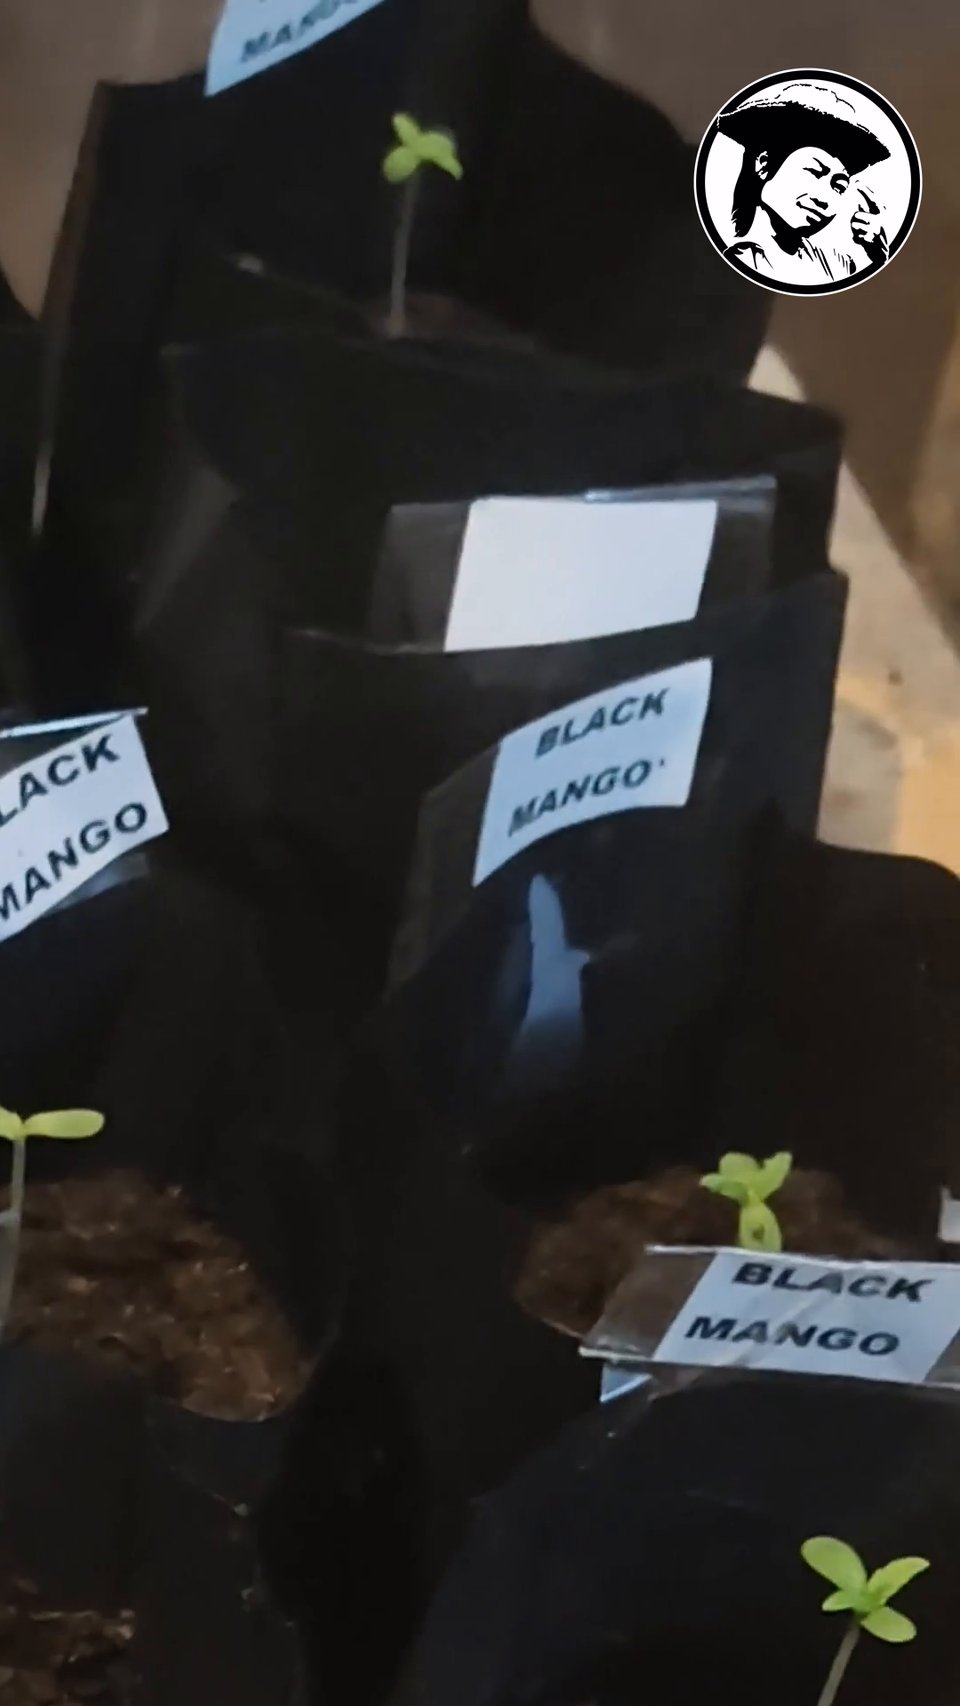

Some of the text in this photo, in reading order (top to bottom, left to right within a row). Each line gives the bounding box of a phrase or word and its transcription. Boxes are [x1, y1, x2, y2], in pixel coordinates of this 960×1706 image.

[535, 687, 669, 758] BLACK
[507, 758, 651, 836] MANGO
[732, 1262, 934, 1303] BLACK
[685, 1316, 900, 1356] MANGO
